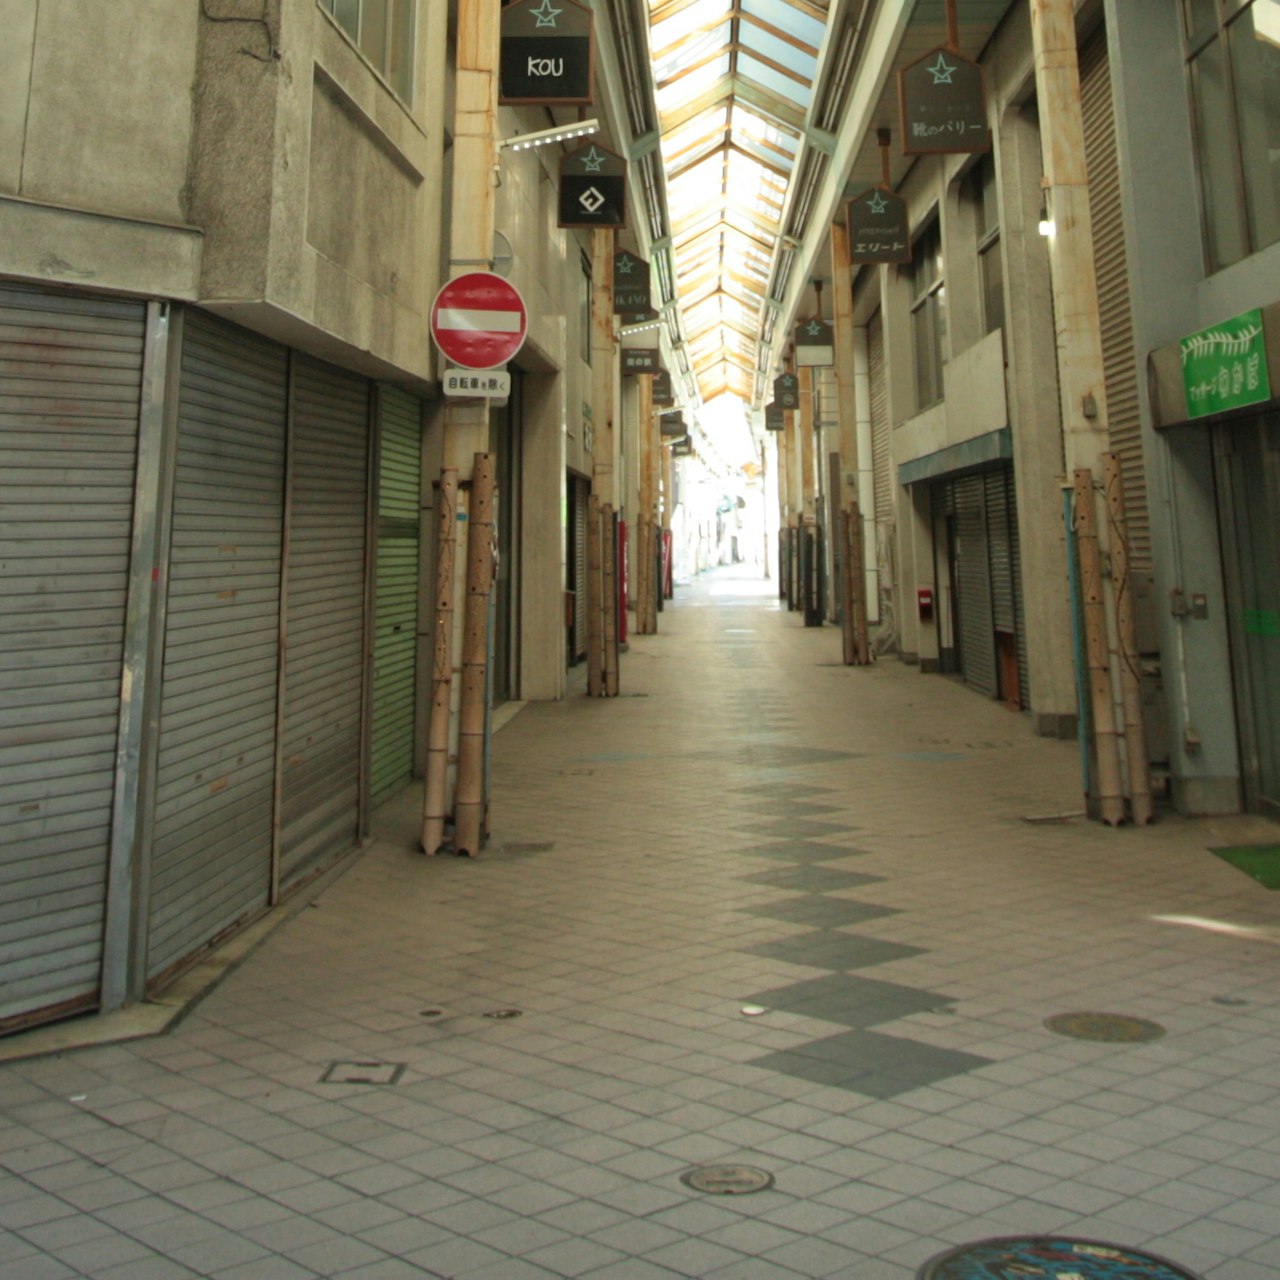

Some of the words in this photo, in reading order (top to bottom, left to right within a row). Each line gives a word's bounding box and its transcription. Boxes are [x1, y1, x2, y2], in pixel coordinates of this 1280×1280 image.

[527, 56, 564, 77] KOU
[854, 241, 906, 253] エリート
[448, 377, 505, 391] 自転車を除く
